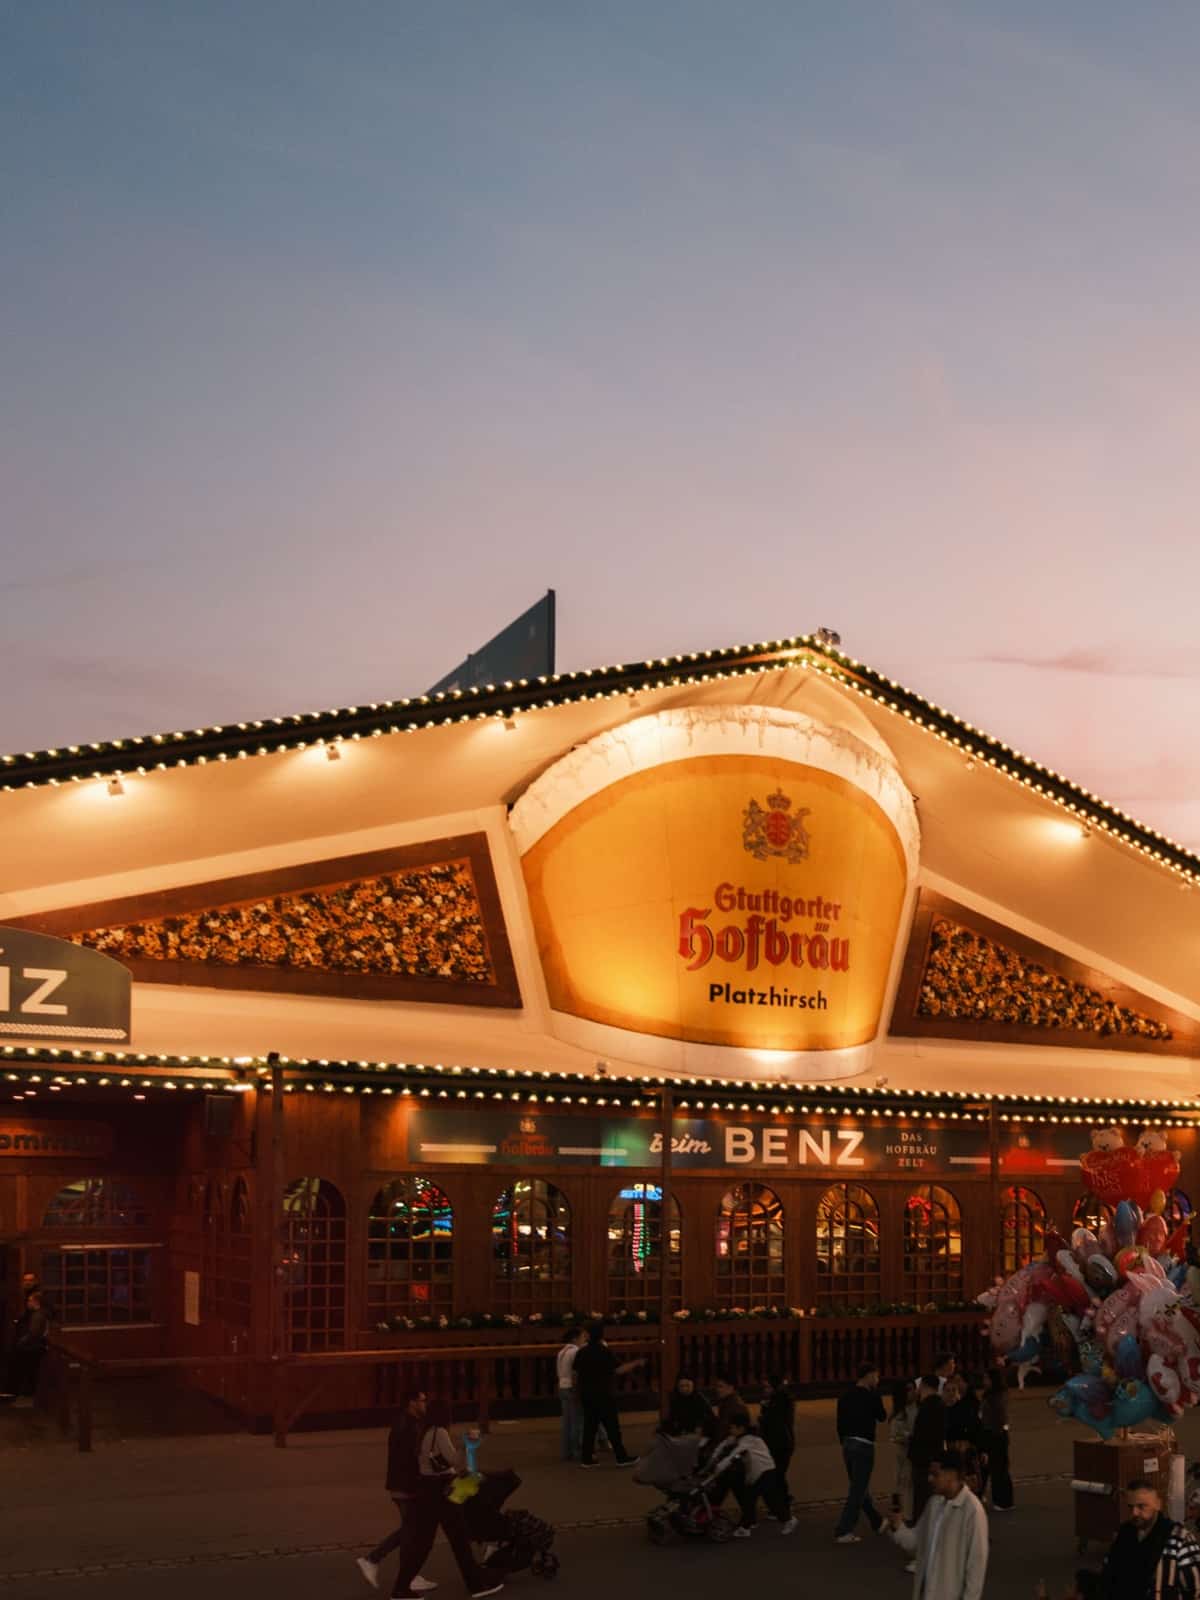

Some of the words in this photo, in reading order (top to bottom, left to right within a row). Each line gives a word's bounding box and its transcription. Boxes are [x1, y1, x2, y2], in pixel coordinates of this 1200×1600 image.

[715, 882, 841, 923] Stuttgarter
[678, 907, 850, 972] Hofbräu
[0, 966, 68, 1015] Z
[709, 982, 827, 1010] Platzhirsch
[725, 1127, 865, 1166] BENZ
[885, 1144, 937, 1156] HOFBRÄU
[898, 1158, 924, 1168] ZELT
